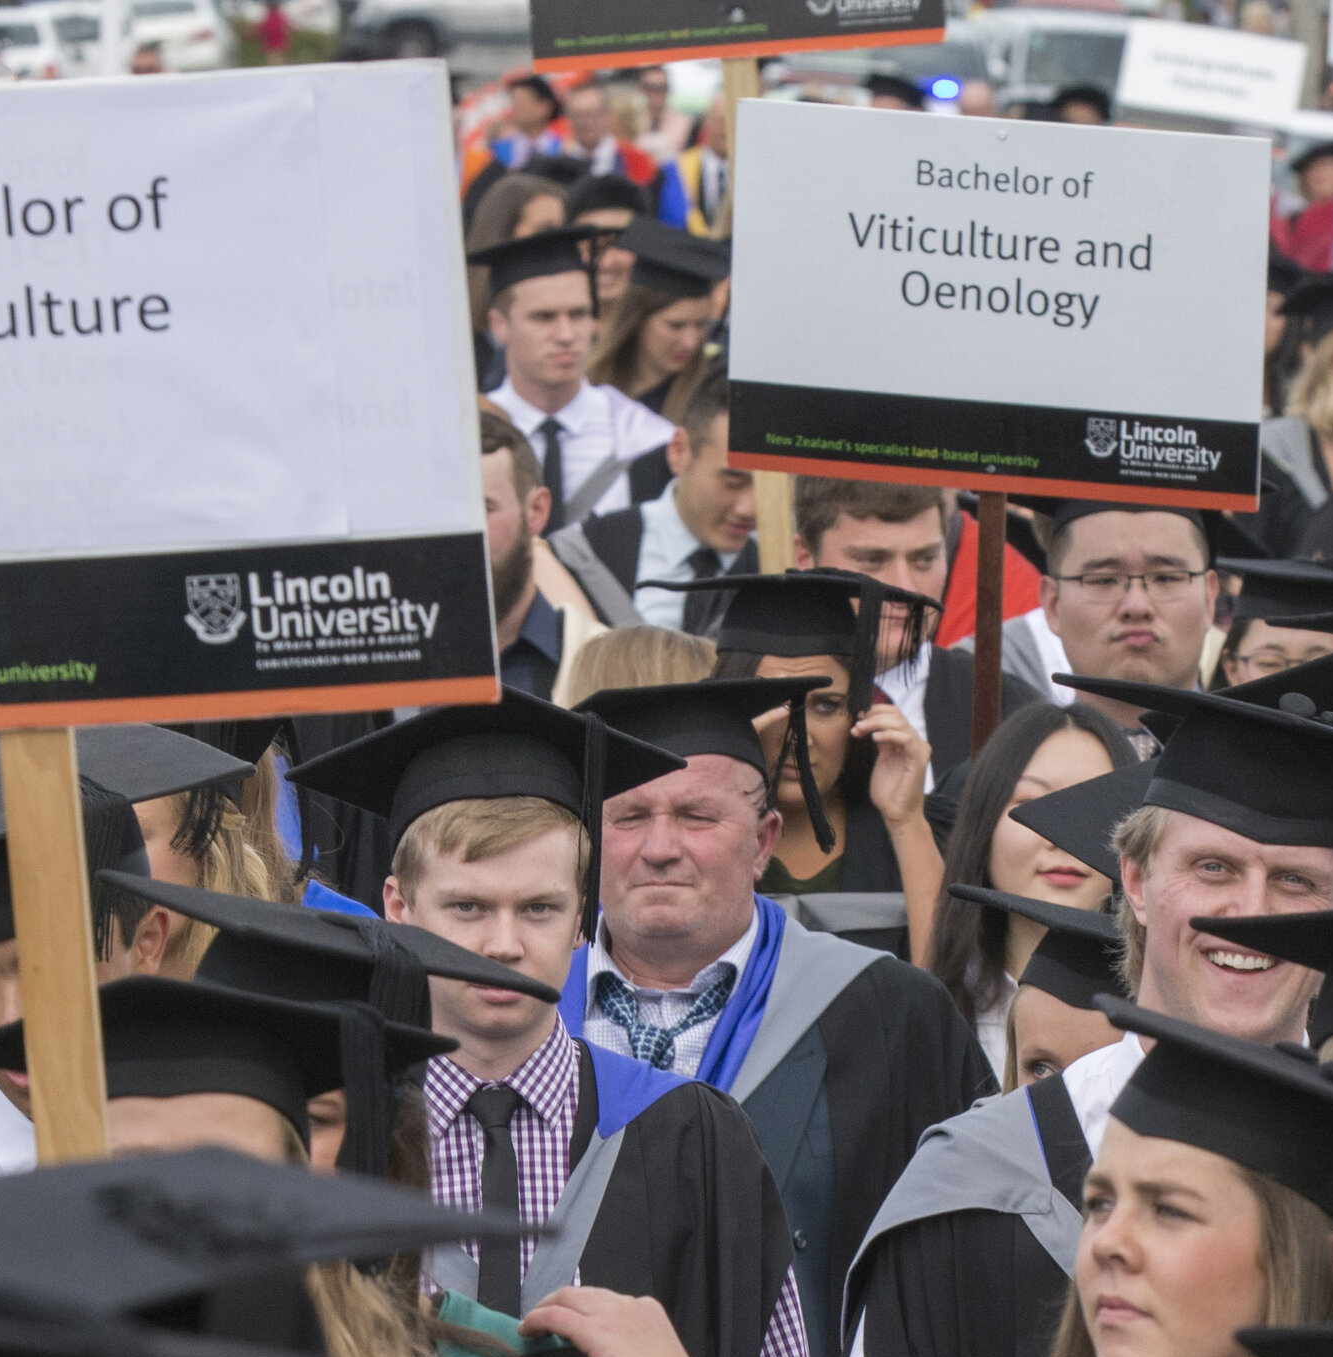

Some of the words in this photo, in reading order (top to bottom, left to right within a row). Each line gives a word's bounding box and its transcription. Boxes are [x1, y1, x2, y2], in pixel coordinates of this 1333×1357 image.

[916, 158, 1054, 197] Bachelor
[1062, 171, 1095, 199] of
[107, 174, 169, 233] of
[848, 211, 1061, 264] Viticulture
[1075, 232, 1153, 271] and
[900, 269, 1101, 330] Oenology
[765, 431, 793, 447] New
[794, 435, 852, 452] Zealand's
[853, 441, 911, 458] specialist
[912, 445, 978, 463] land-based
[979, 453, 1041, 470] university
[1120, 420, 1197, 446] Lincoln
[1120, 440, 1221, 470] University
[248, 565, 392, 606] Lincoln
[251, 597, 440, 640] University
